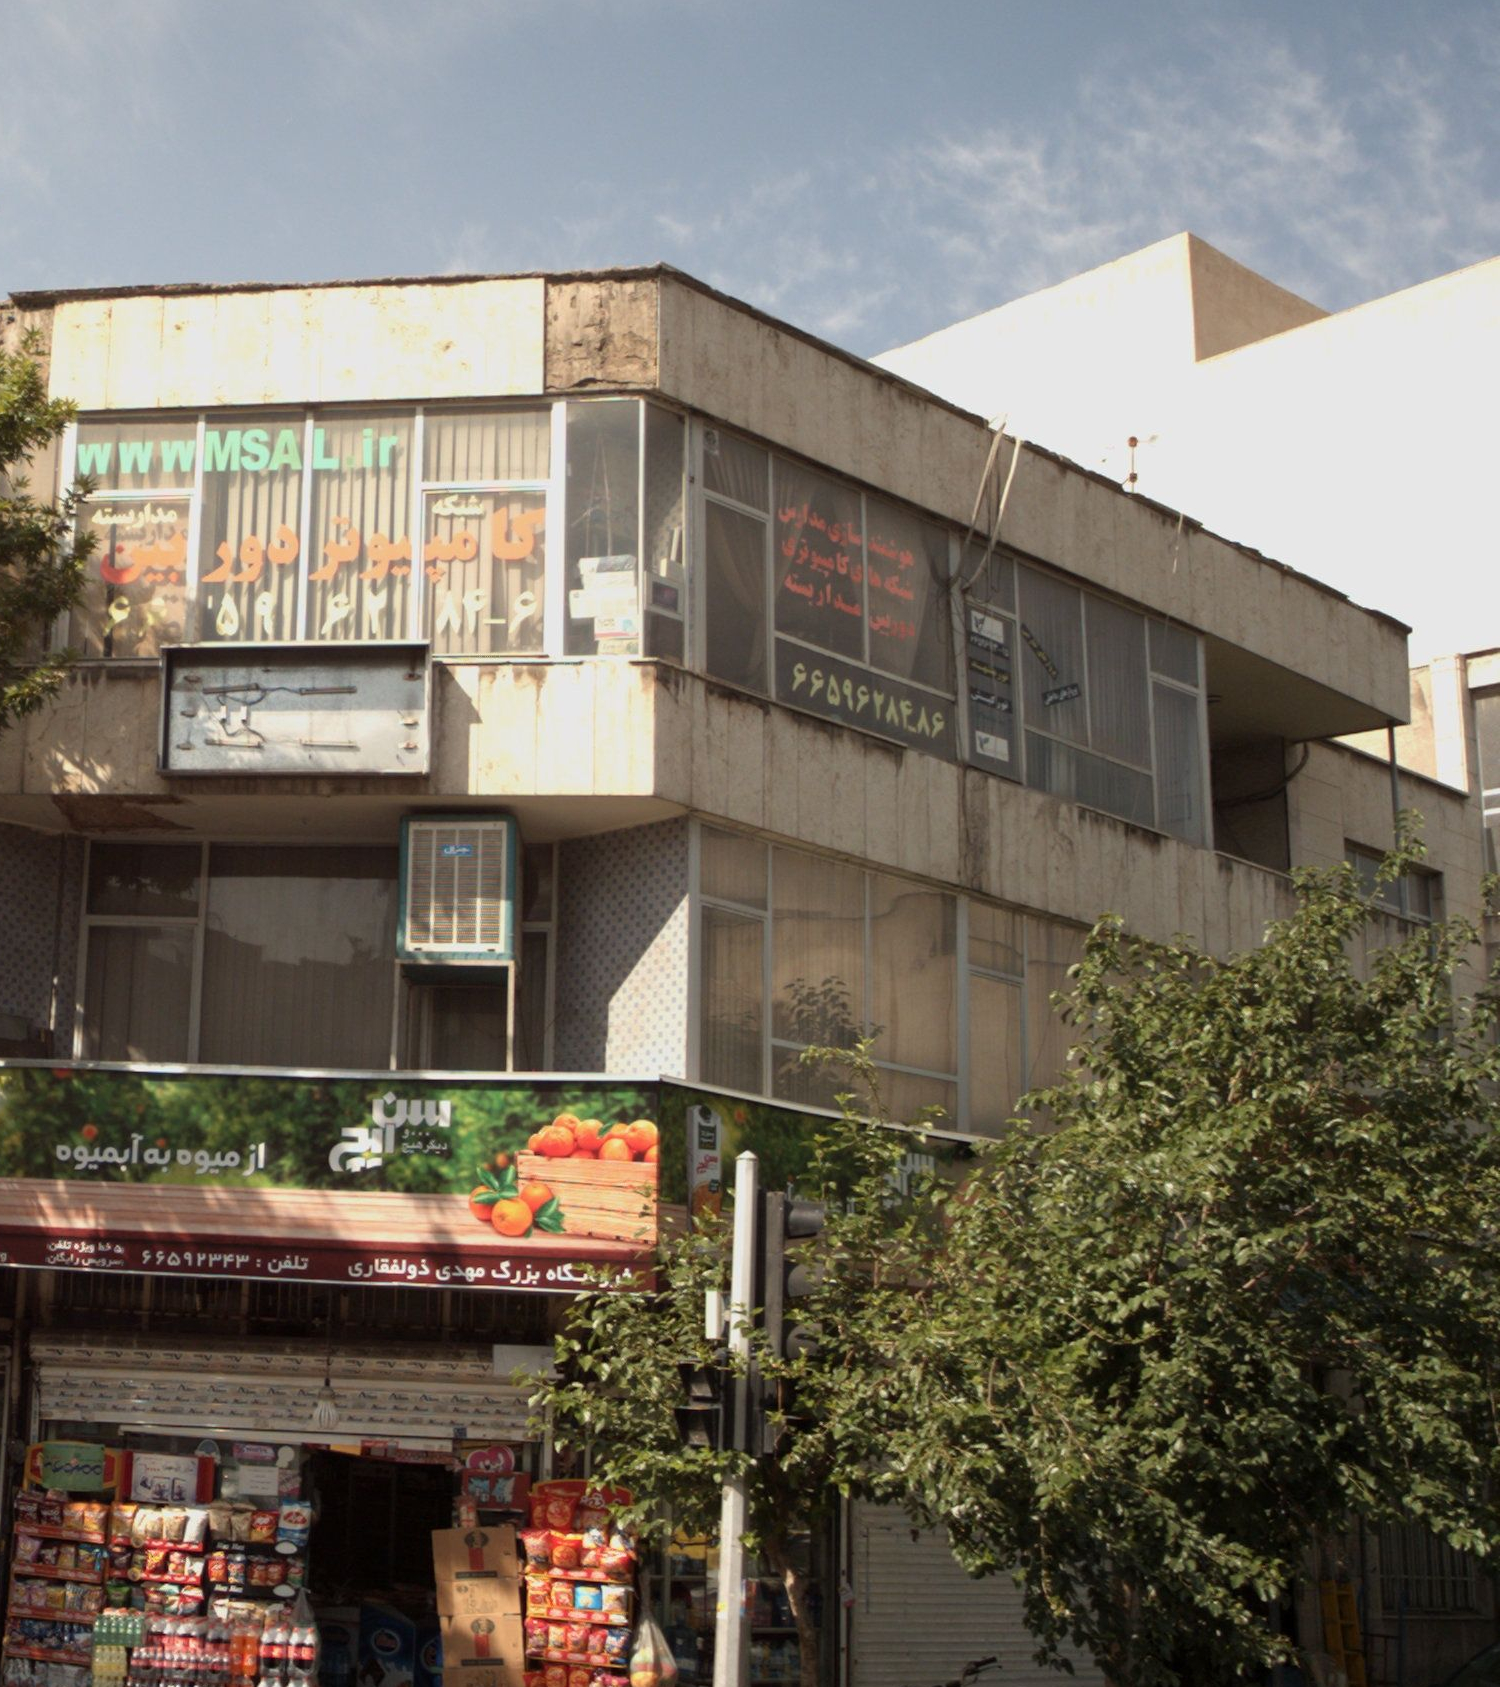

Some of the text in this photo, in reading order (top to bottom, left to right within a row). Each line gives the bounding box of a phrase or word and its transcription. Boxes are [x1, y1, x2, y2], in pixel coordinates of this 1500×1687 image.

[431, 493, 485, 521] شبکه
[56, 1132, 266, 1177] از میوه به آبمیوه
[347, 1257, 431, 1279] ذولفقاری
[435, 1264, 487, 1283] مهدی
[491, 1261, 541, 1286] بزرگ
